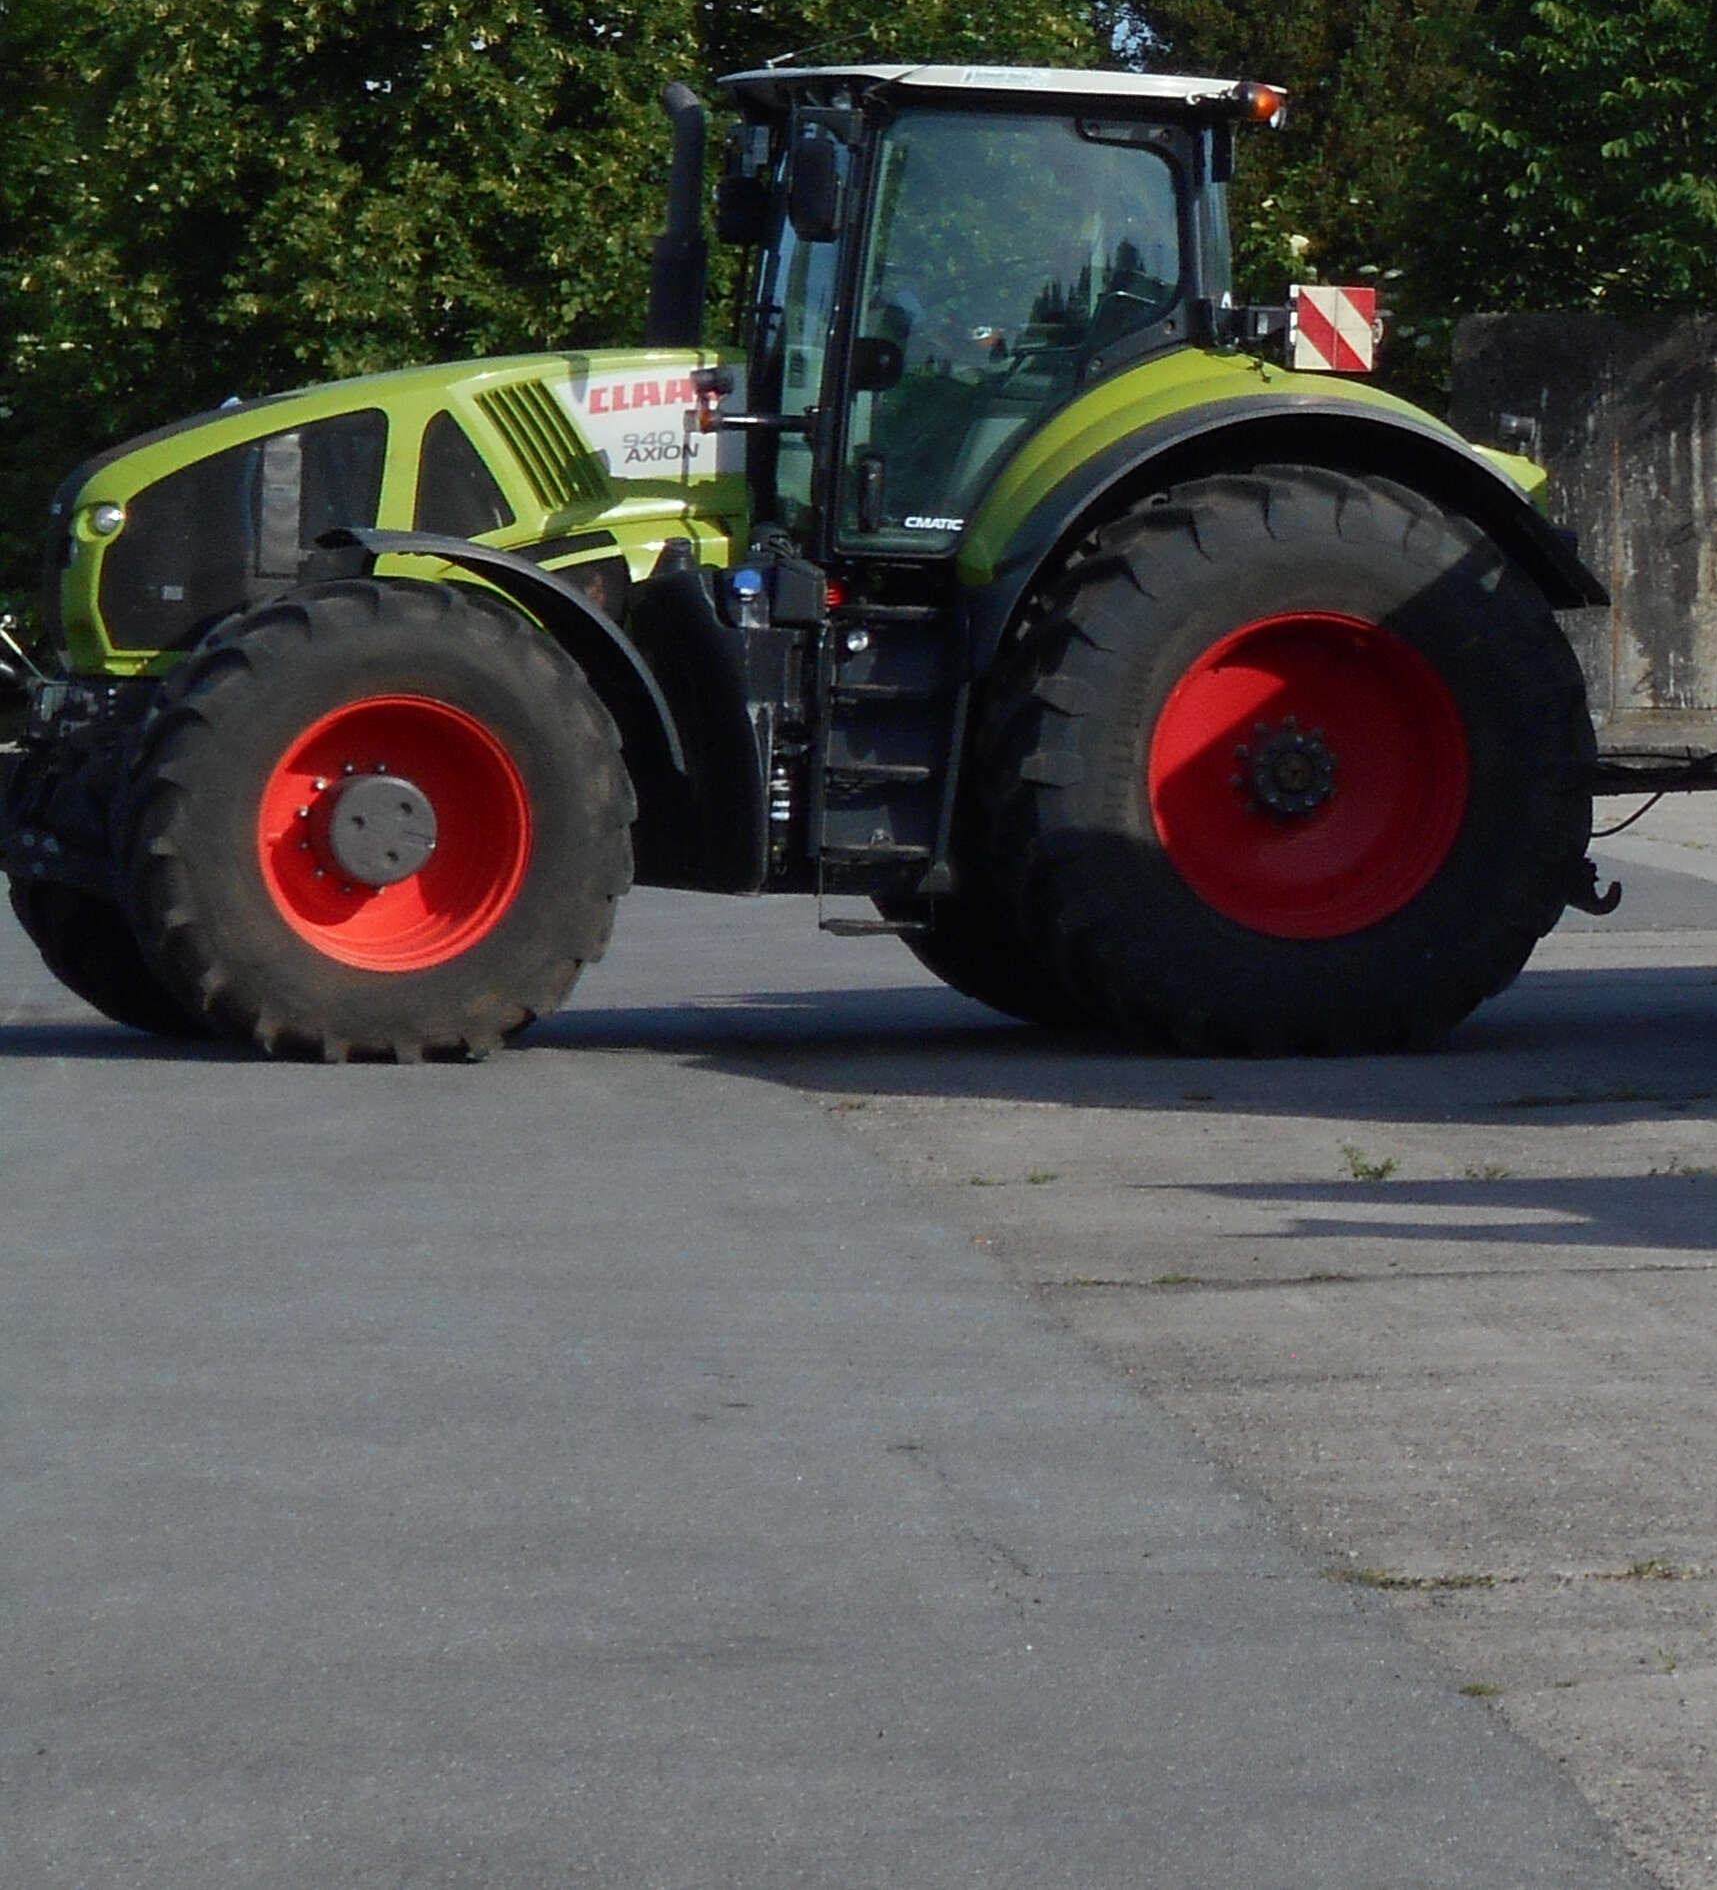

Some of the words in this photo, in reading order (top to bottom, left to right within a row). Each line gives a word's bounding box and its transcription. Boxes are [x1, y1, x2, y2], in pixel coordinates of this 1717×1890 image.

[589, 372, 714, 415] CLAA
[623, 431, 675, 448] 940
[625, 443, 699, 464] AXION
[904, 516, 964, 531] CMATIC
